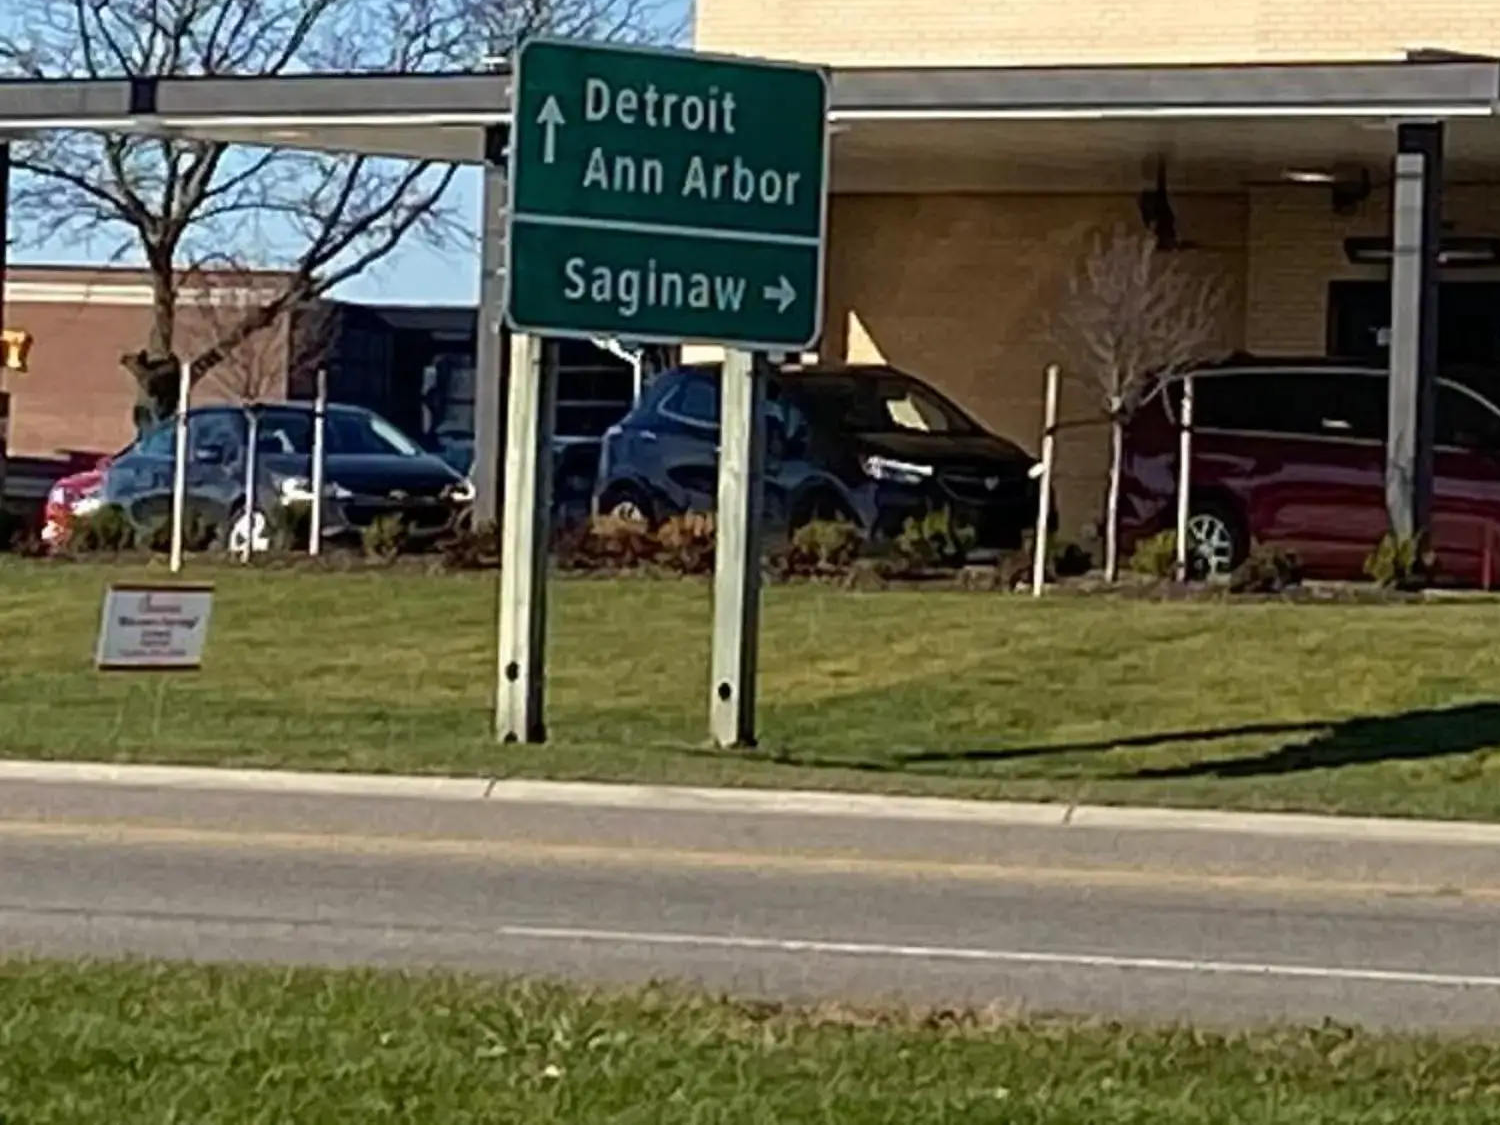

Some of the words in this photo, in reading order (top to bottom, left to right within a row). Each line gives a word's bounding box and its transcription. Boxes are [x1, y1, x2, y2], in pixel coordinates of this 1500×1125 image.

[585, 78, 737, 134] Detroit
[582, 147, 663, 194] Ann
[681, 156, 801, 205] Arbor
[563, 257, 746, 316] Saginaw
